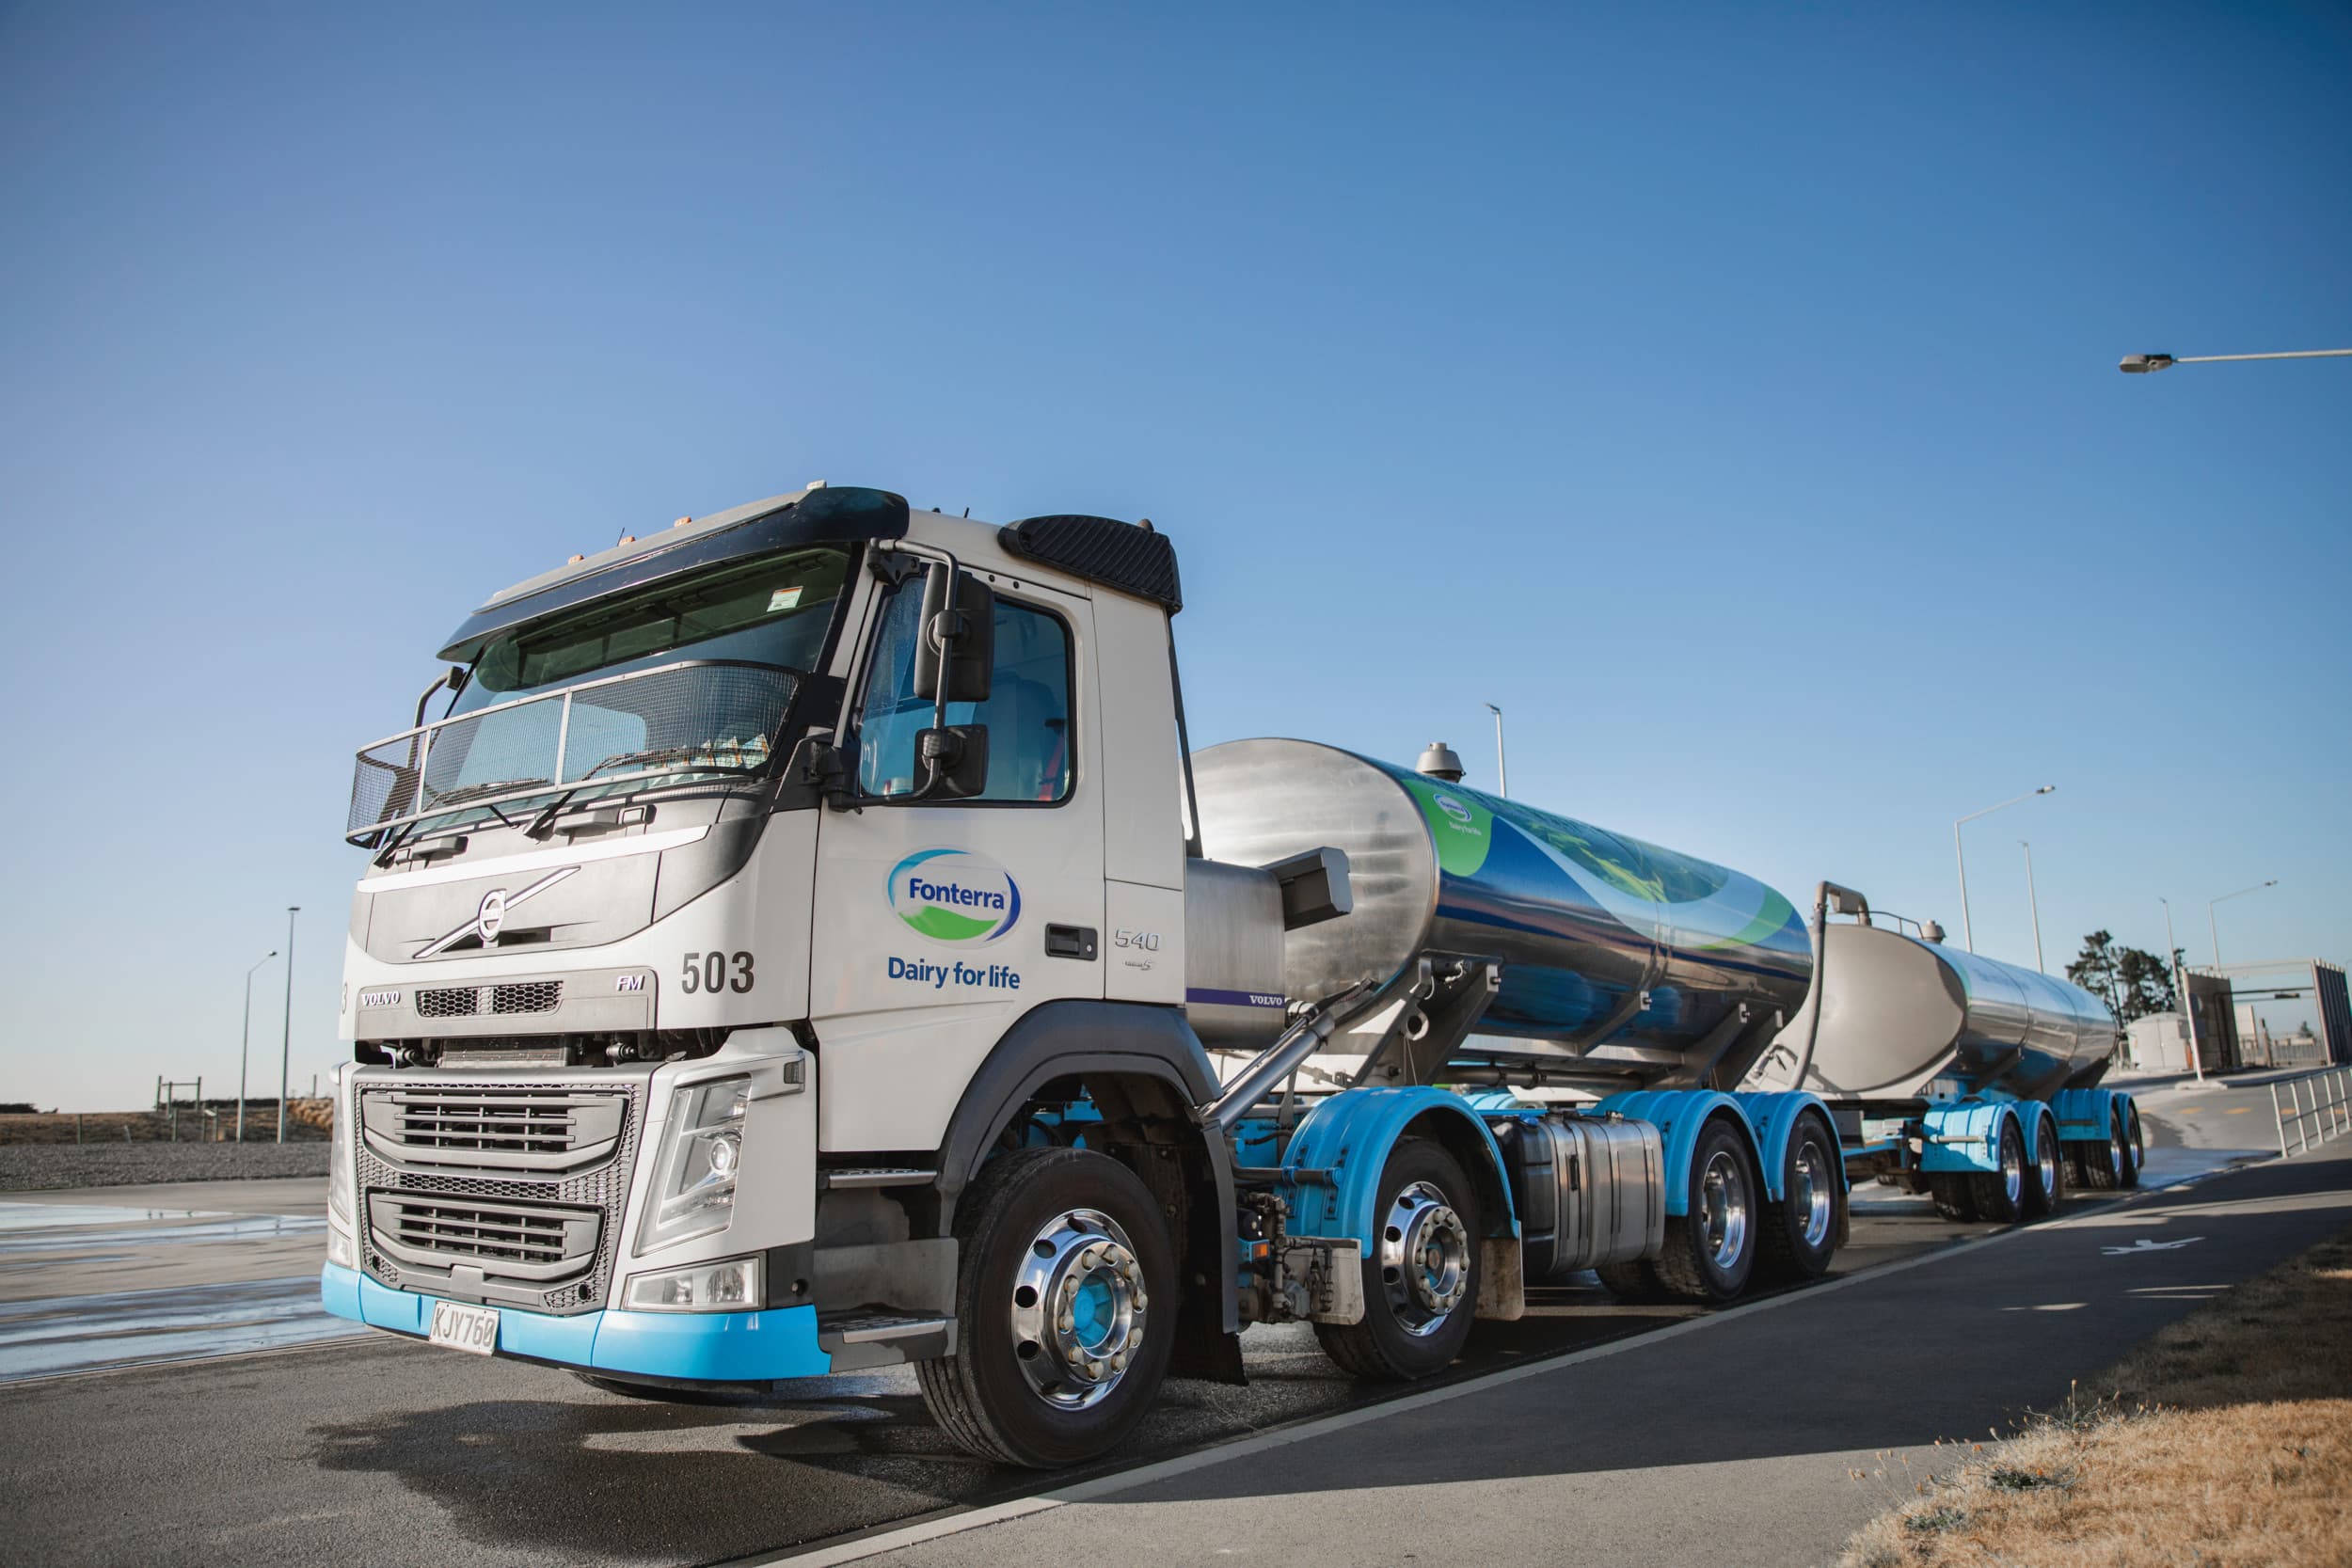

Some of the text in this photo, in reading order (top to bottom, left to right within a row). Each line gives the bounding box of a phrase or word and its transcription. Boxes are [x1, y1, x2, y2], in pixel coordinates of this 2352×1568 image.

[909, 878, 1005, 911] Fonterra
[1115, 928, 1160, 952] 540
[616, 974, 645, 991] FM
[681, 951, 755, 994] 503
[888, 957, 1021, 990] Dairy for life
[360, 990, 402, 1006] VOLVO
[1249, 995, 1283, 1006] VOLVO
[432, 1307, 496, 1347] KJY760
